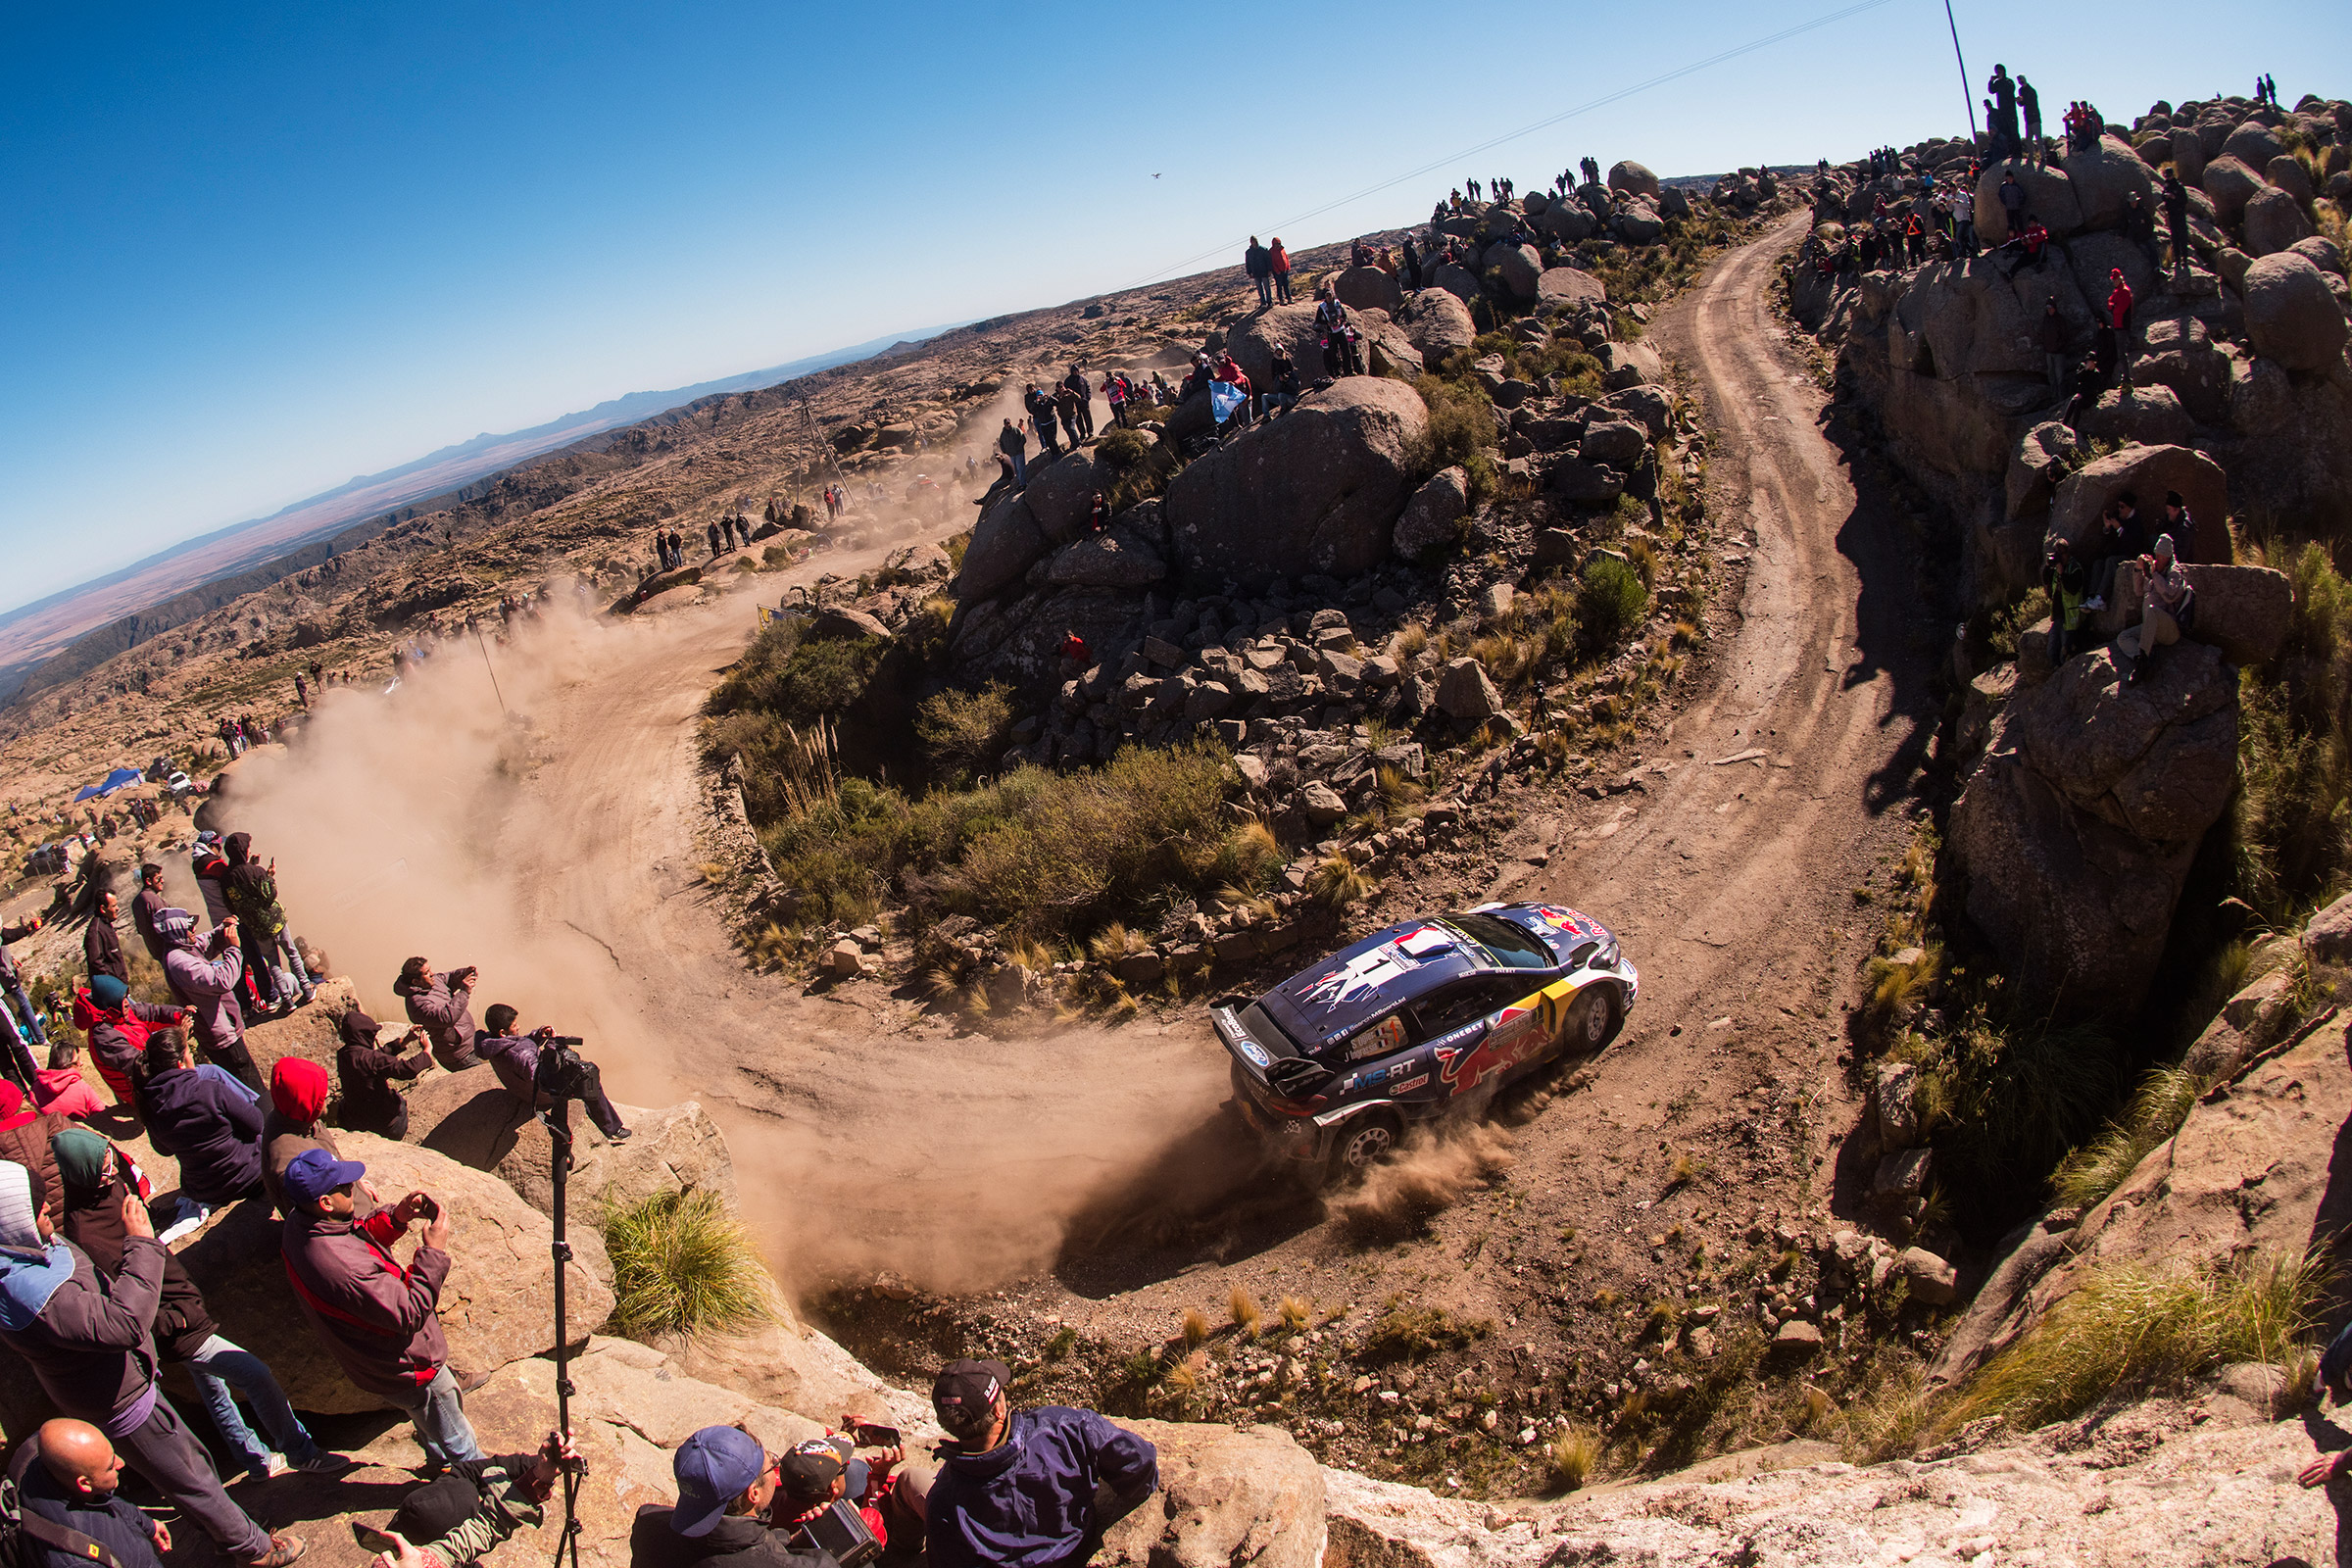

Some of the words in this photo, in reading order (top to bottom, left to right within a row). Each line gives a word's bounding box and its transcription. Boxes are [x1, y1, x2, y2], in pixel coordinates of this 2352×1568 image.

[1362, 958, 1391, 975] 1
[1390, 1020, 1399, 1043] 1
[1446, 1022, 1483, 1043] ONEBET
[1397, 1076, 1428, 1093] Castrol
